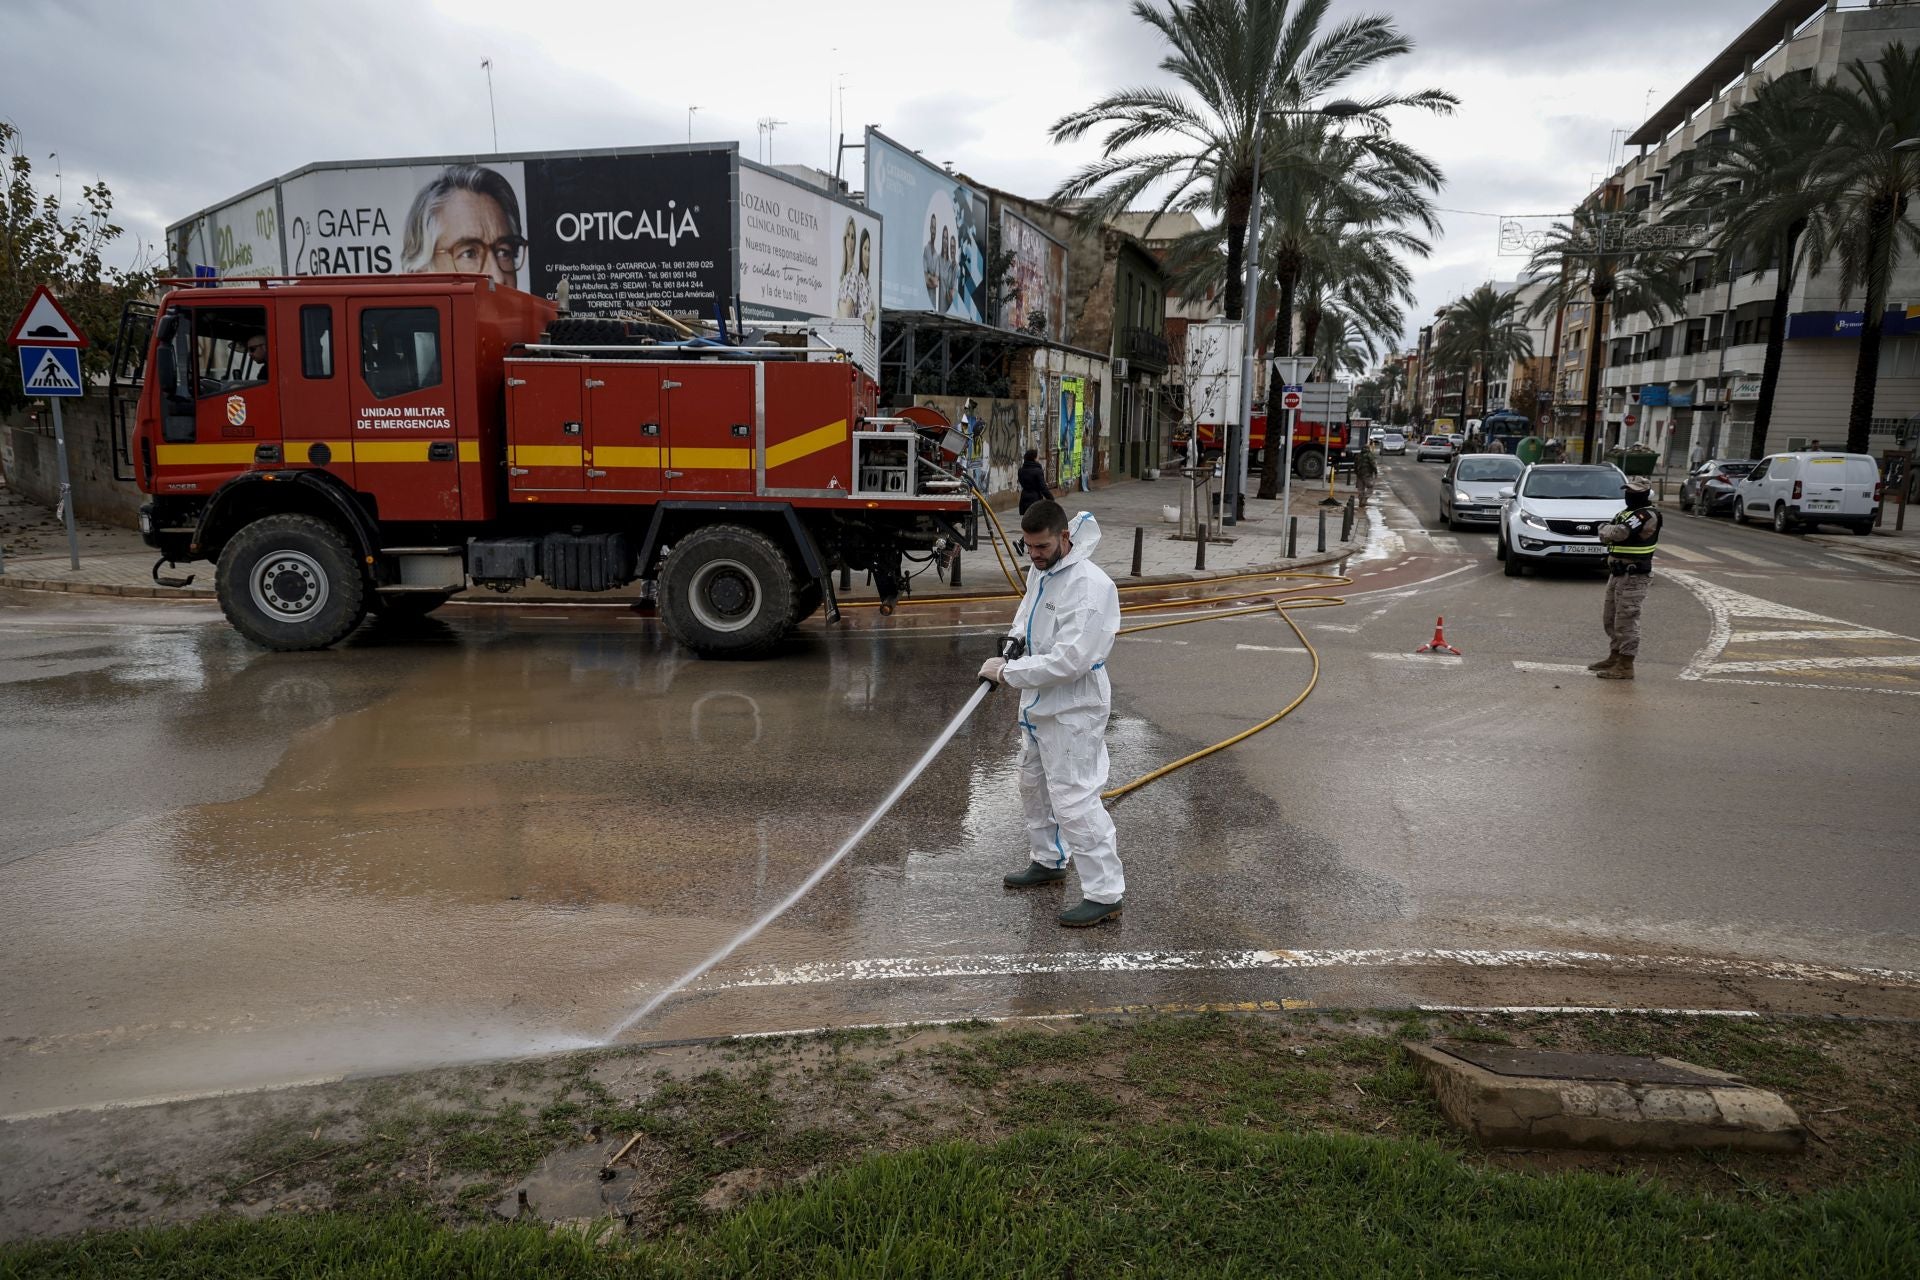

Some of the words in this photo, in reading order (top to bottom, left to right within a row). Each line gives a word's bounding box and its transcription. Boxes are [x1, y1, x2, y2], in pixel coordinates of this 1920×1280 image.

[740, 191, 780, 217] LOZANO
[787, 207, 818, 231] CUESTA
[317, 207, 391, 237] GAFA
[776, 223, 801, 241] DENTAL
[745, 237, 771, 255] Nuestra
[772, 246, 818, 267] responsabilidad
[309, 245, 393, 276] GRATIS
[545, 264, 554, 272] C/
[555, 263, 580, 272] Filiberto
[580, 263, 606, 272] Rodrigo,
[606, 262, 612, 271] 9
[615, 262, 657, 270] CATARROJA
[661, 261, 672, 269] Tel.
[673, 261, 685, 269] 961
[686, 261, 699, 269] 269
[700, 260, 714, 269] 025
[561, 273, 570, 281] C/
[571, 273, 592, 281] Jaume
[597, 272, 606, 280] 20
[610, 271, 644, 280] PAIPORTA
[648, 271, 659, 279] Tel.
[660, 271, 672, 279] 961
[672, 271, 684, 279] 951
[685, 270, 697, 279] 148
[752, 261, 781, 279] cuidar
[782, 264, 804, 281] tu
[582, 282, 610, 291] Albufera,
[609, 281, 619, 289] 25
[652, 281, 663, 289] Tel.
[676, 280, 690, 288] 844
[690, 280, 704, 288] 244
[546, 293, 554, 301] C/
[582, 291, 597, 299] Furió
[597, 291, 614, 300] Roca,
[627, 291, 645, 300] Vedat,
[645, 291, 661, 300] junto
[661, 290, 672, 299] CC
[672, 290, 684, 298] Las
[684, 289, 716, 299] Américas)
[761, 286, 766, 298] y
[767, 283, 773, 297] la
[773, 286, 782, 298] de
[783, 287, 793, 300] tus
[793, 289, 808, 305] hijos
[588, 300, 622, 308] TORRENTE
[635, 299, 647, 307] 961
[660, 299, 672, 308] 347
[570, 310, 597, 319] Uruguay,
[598, 310, 605, 318] 17
[361, 407, 402, 417] UNIDAD
[403, 407, 445, 417] MILITAR
[357, 420, 372, 429] DE
[374, 419, 451, 429] EMERGENCIAS
[1567, 545, 1586, 553] 7049
